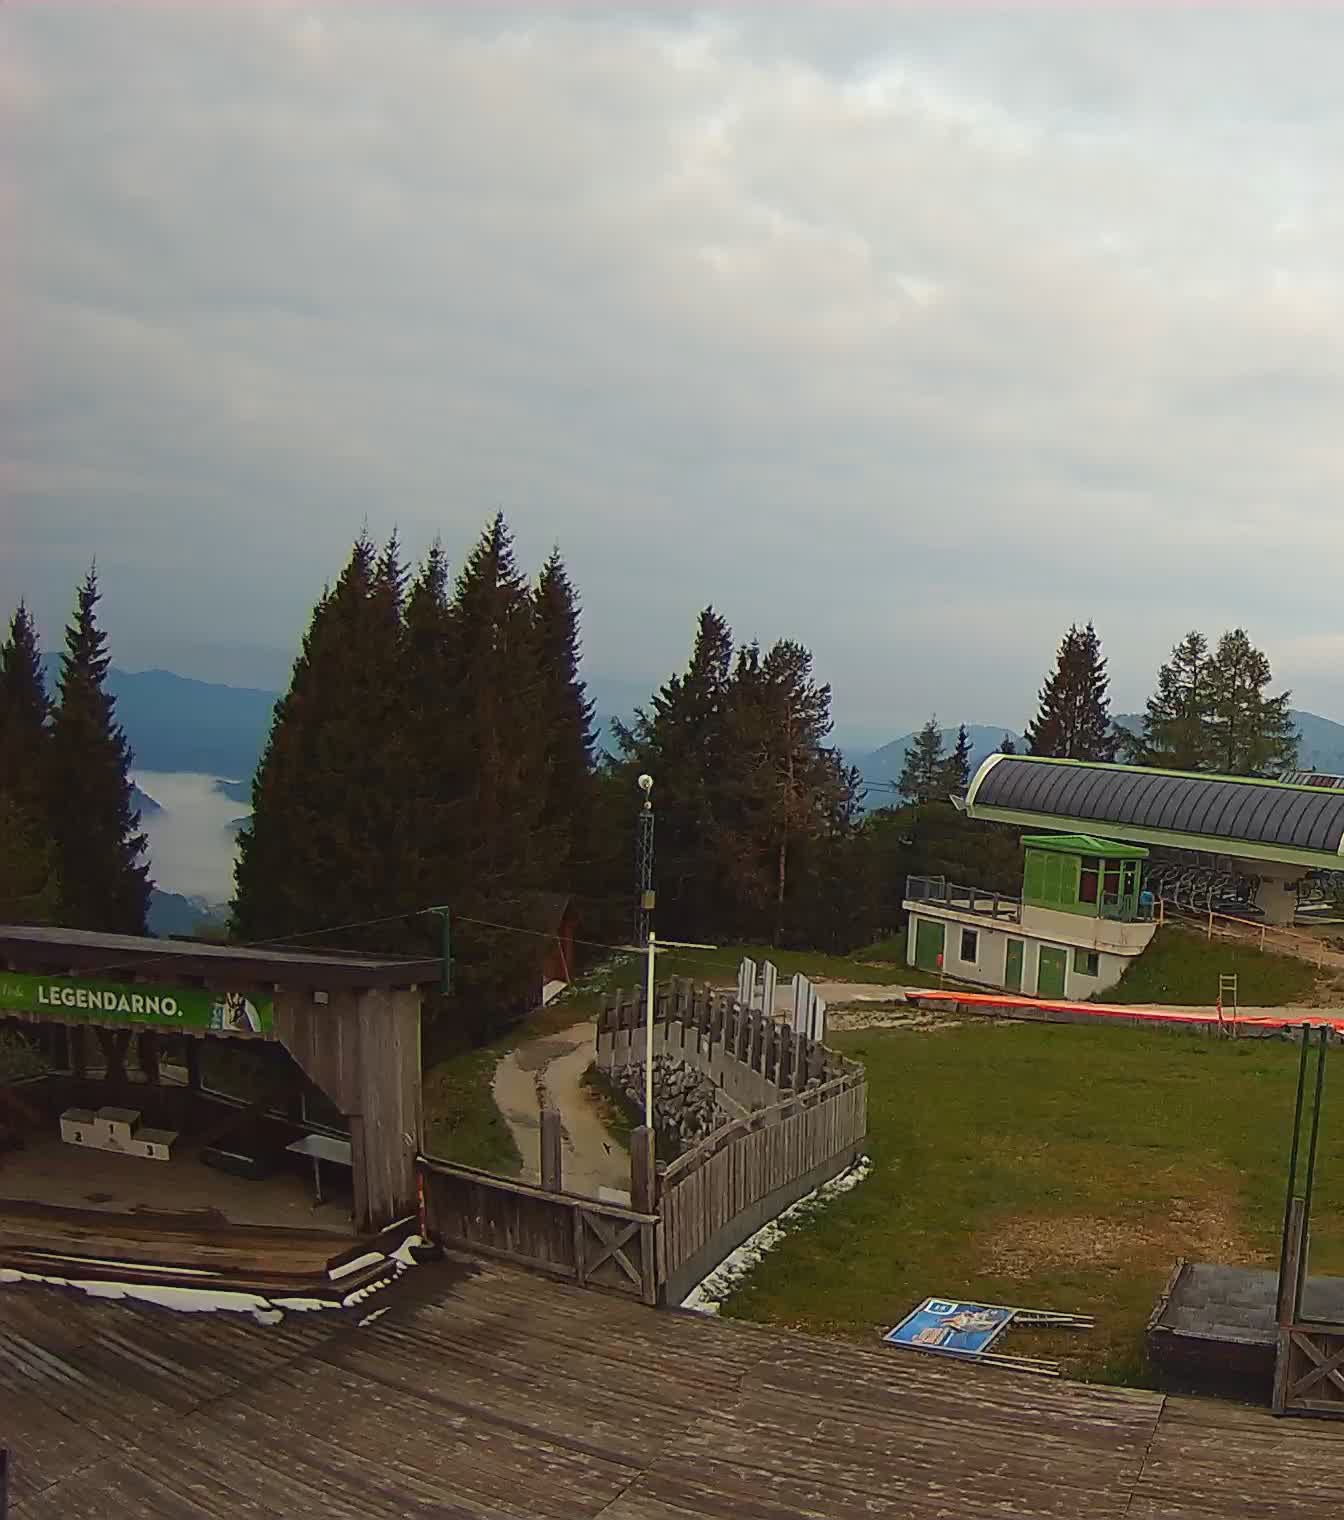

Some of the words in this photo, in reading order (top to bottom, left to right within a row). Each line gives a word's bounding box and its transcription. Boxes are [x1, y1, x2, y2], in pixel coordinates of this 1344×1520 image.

[39, 986, 183, 1016] LEGENDARNO.
[75, 1131, 82, 1142] 2
[109, 1124, 114, 1135] 1
